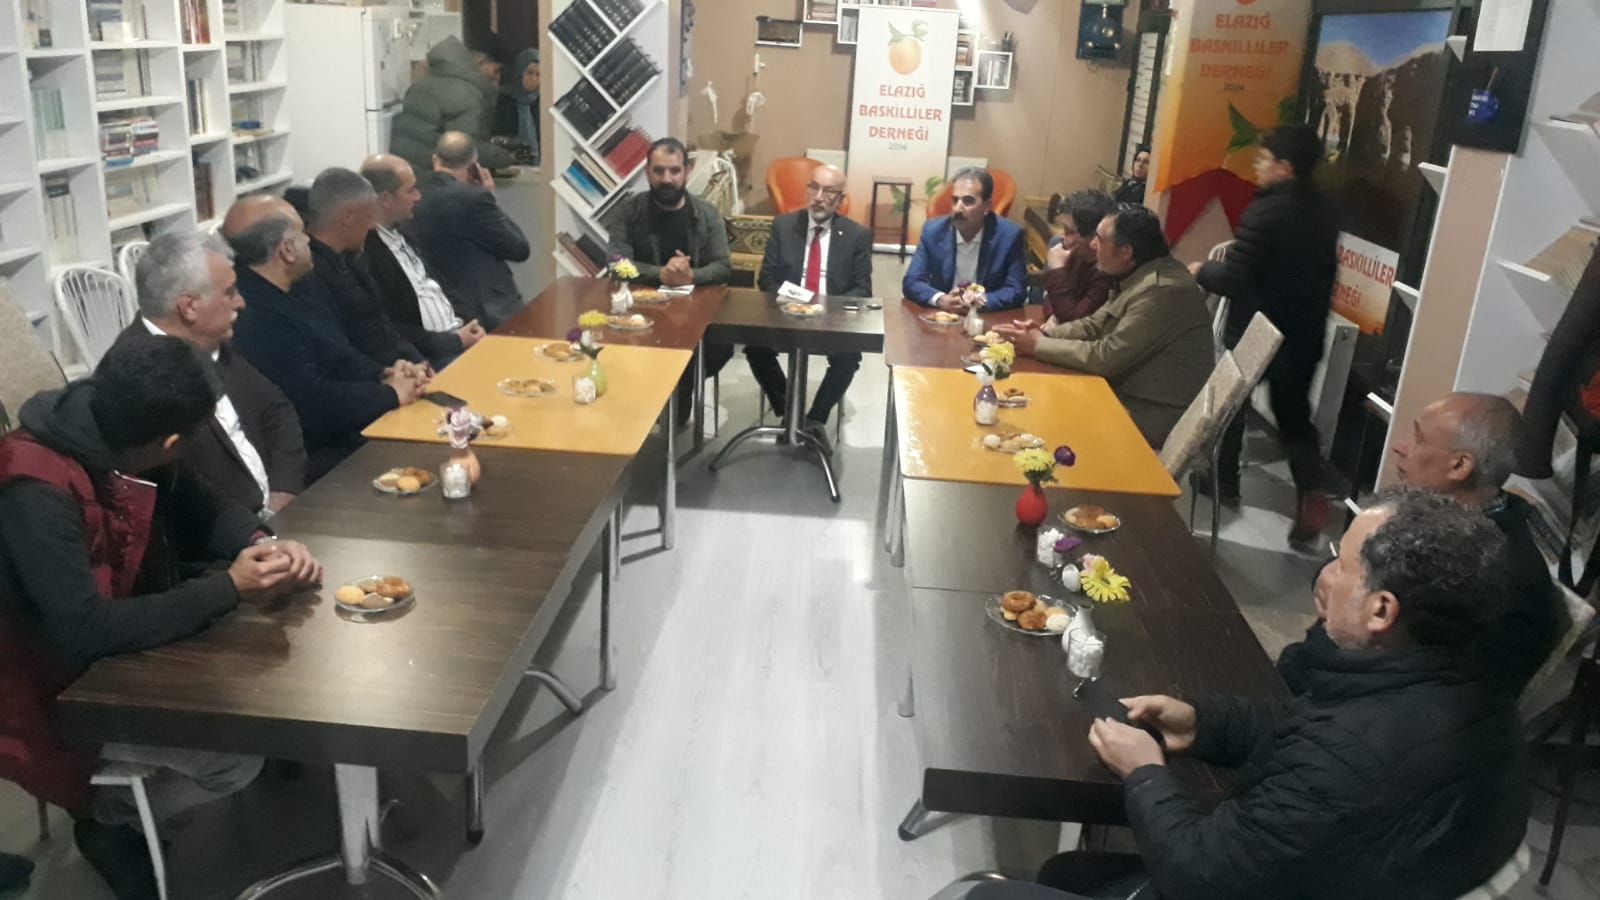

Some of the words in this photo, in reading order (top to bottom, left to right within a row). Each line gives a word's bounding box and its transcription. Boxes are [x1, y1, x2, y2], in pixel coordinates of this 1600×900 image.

[1215, 12, 1271, 29] ELAZIĞ
[880, 84, 926, 98] ELAZIĞ
[859, 104, 942, 121] BASKİLLİLER
[869, 126, 928, 140] DERNEĞİ
